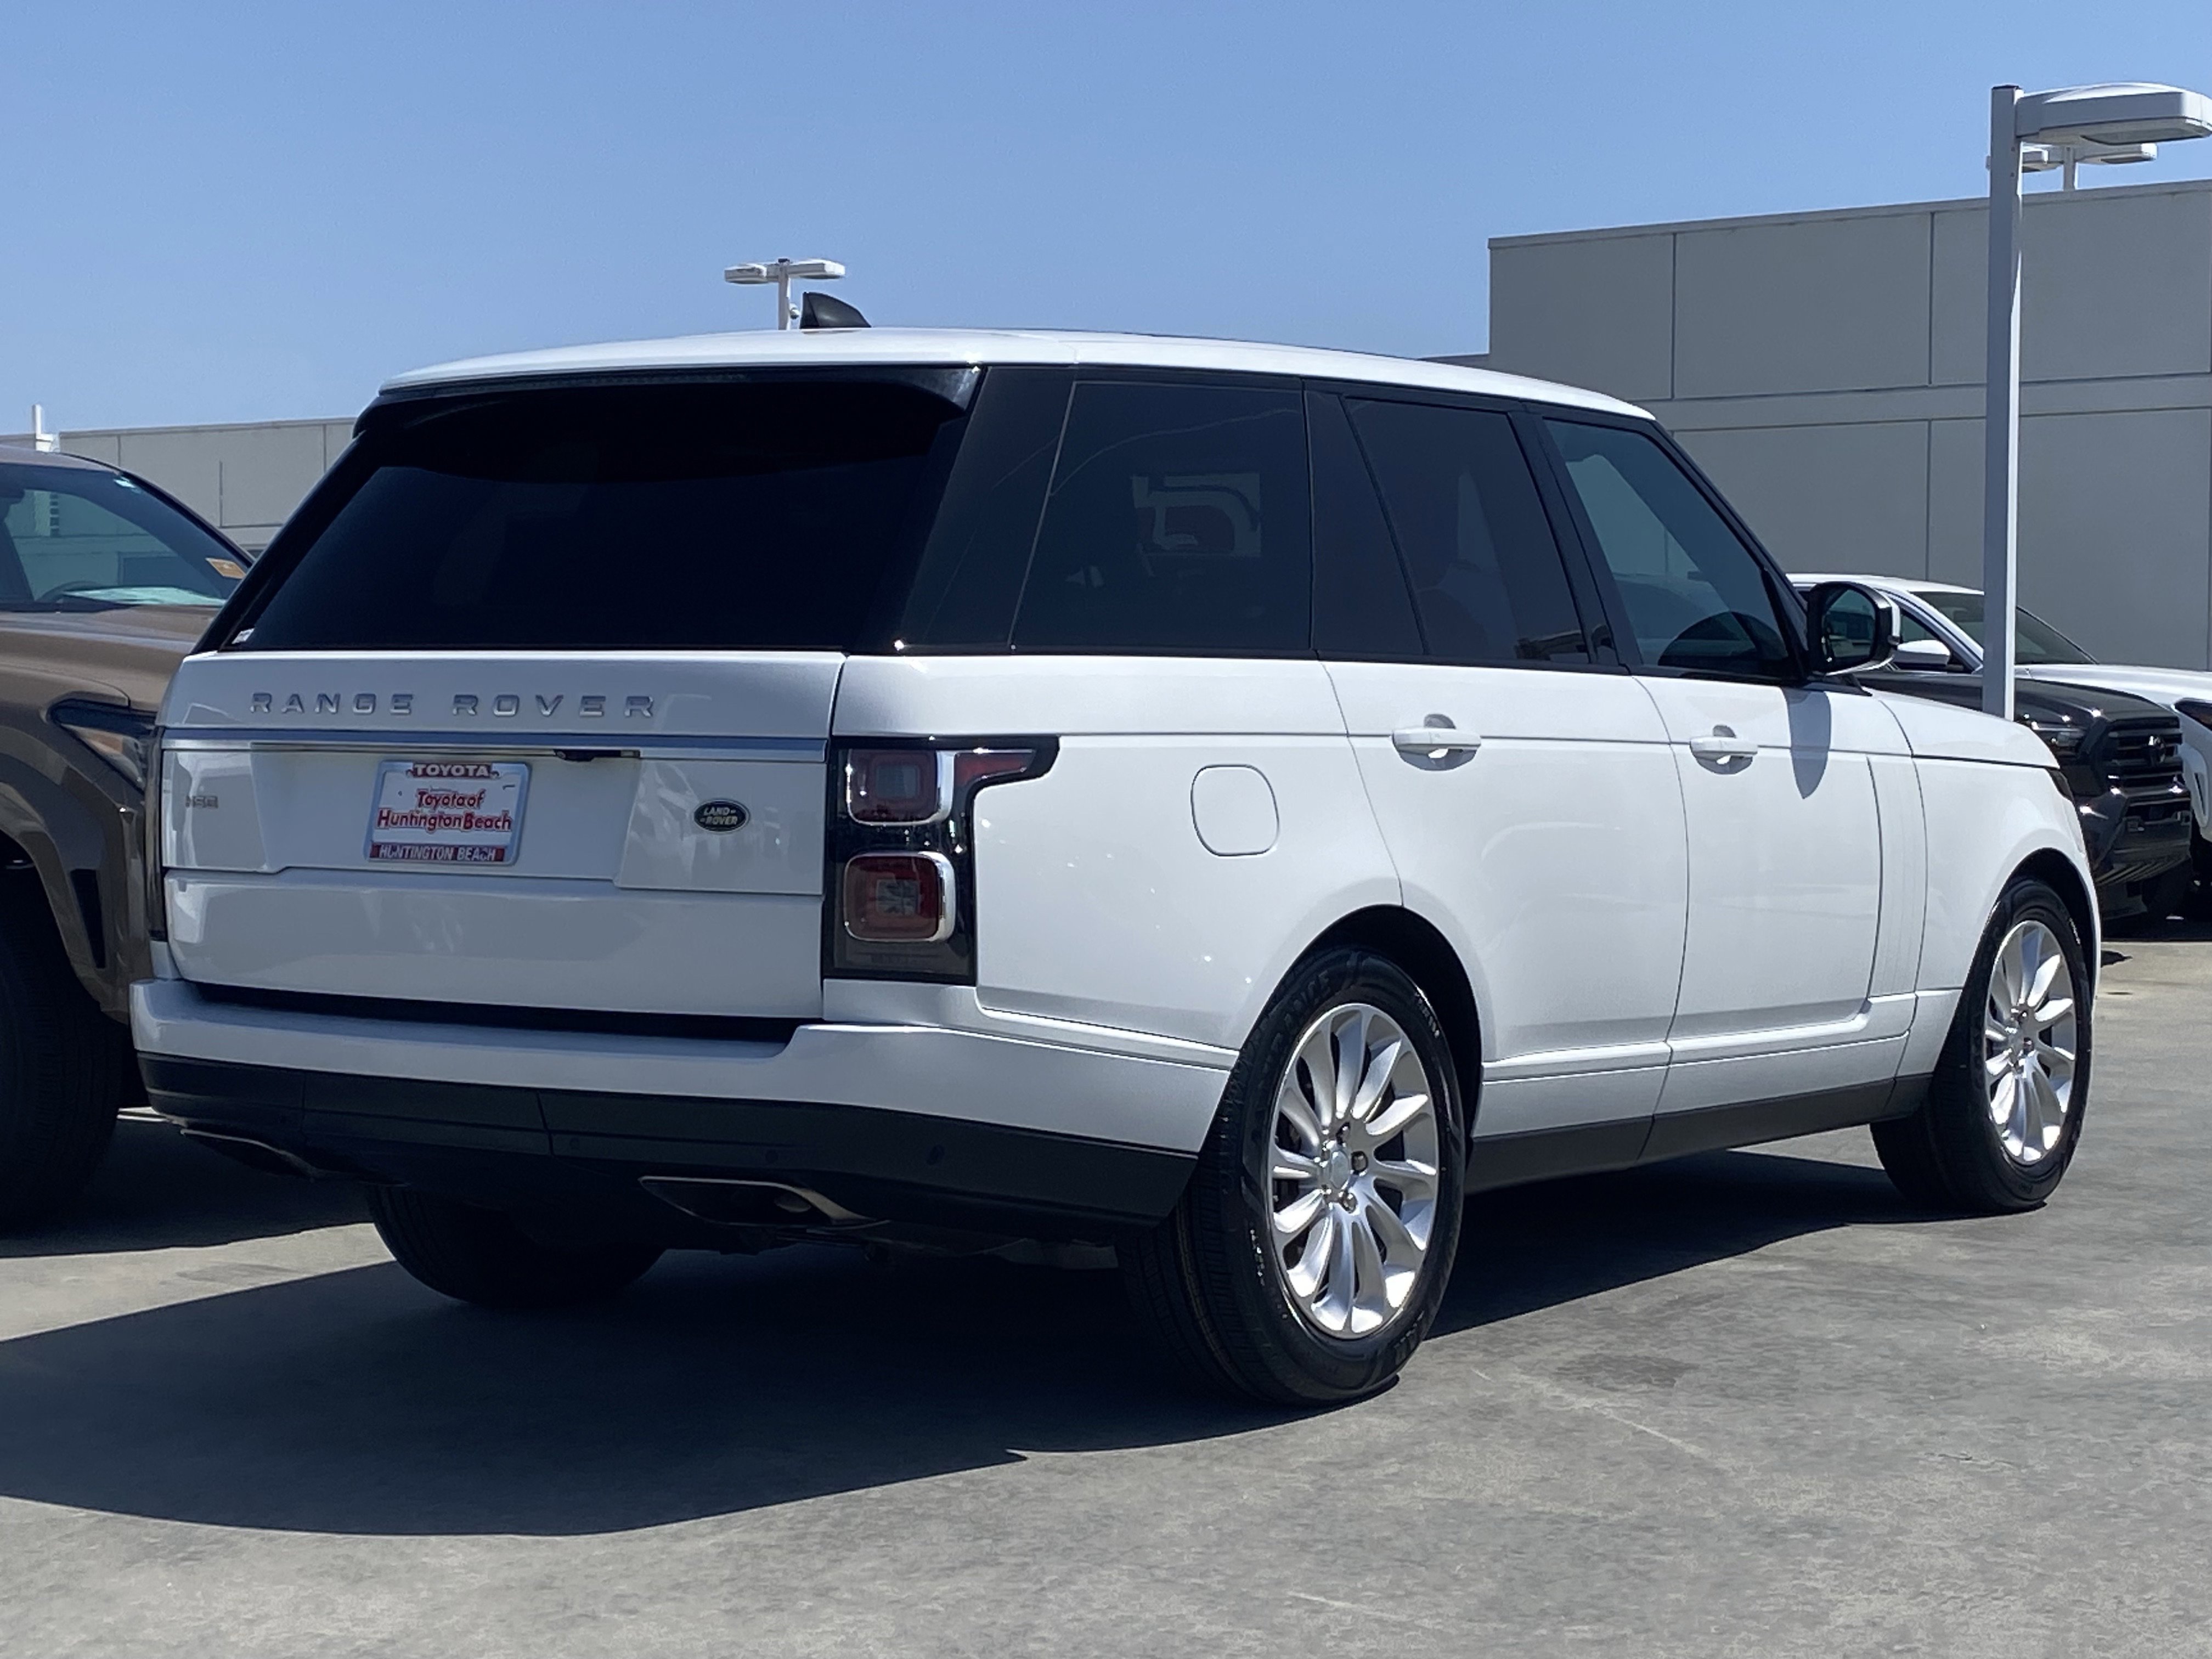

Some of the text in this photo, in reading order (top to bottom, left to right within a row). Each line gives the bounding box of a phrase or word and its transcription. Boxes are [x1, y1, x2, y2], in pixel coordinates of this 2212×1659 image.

[249, 692, 655, 717] RANGE ROVER
[414, 764, 489, 777] TOYOTA
[417, 788, 486, 810] Toyota of
[376, 808, 513, 833] Huntington Beach
[379, 845, 496, 862] HUNTINGTON BEACH
